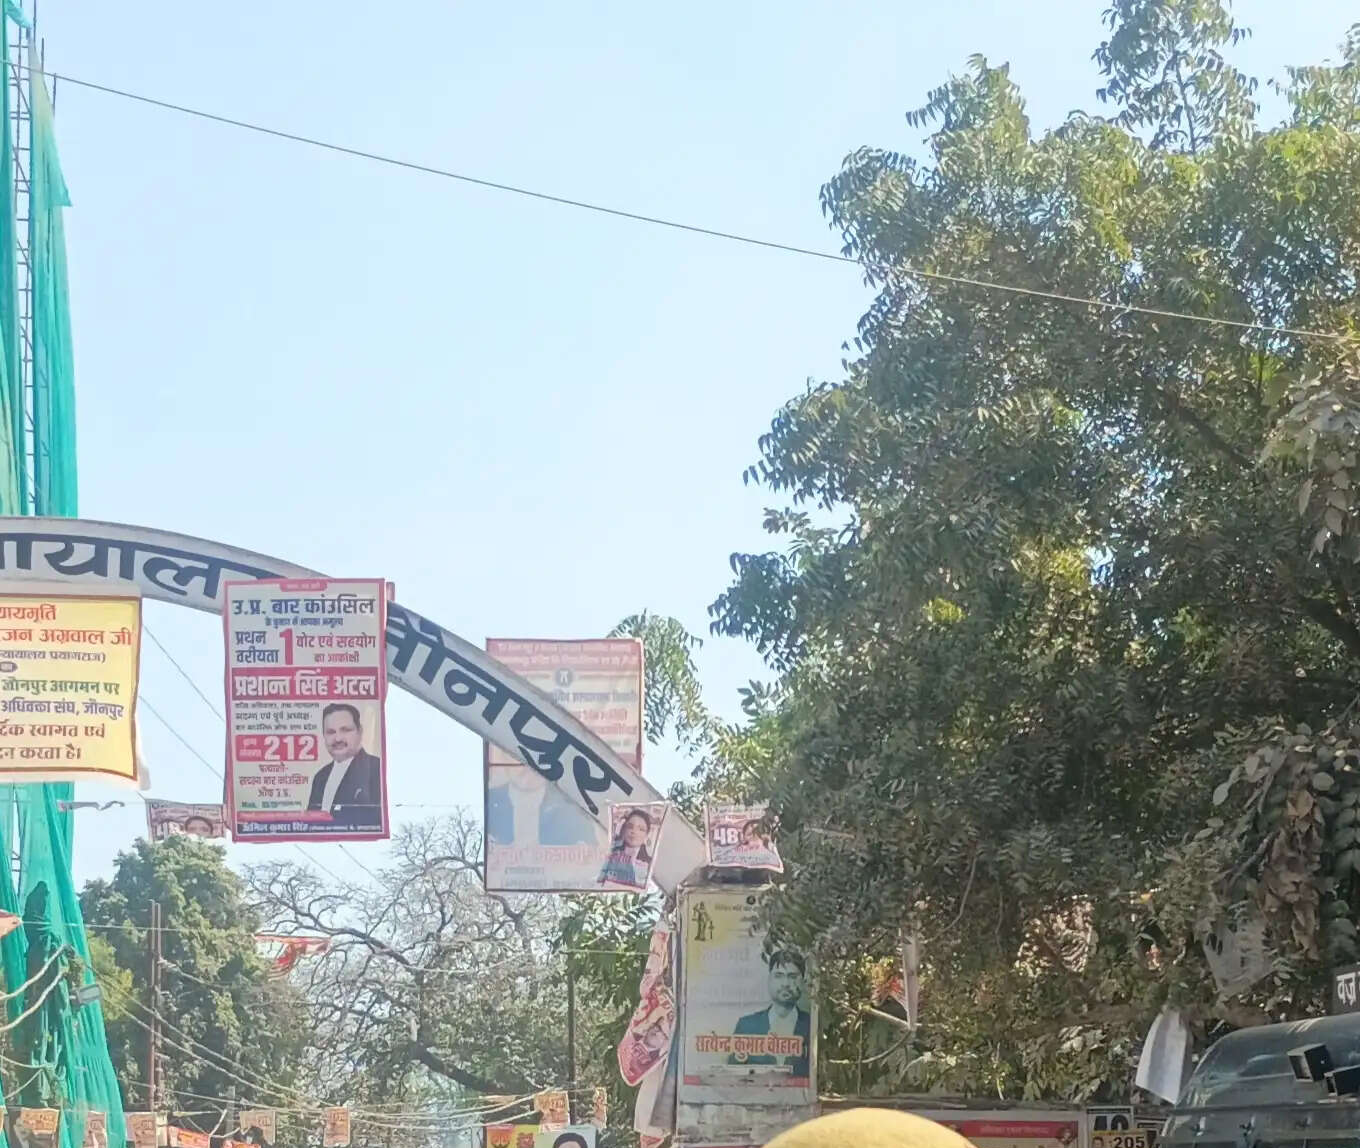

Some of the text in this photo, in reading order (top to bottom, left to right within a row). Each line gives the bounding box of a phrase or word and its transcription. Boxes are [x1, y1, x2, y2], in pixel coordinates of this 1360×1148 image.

[270, 599, 301, 614] बार
[39, 628, 105, 646] अग्रवाल
[110, 627, 133, 647] जी
[296, 632, 315, 648] वोट
[336, 632, 377, 649] सहयोग
[235, 646, 280, 664] वरीयता
[1, 676, 48, 696] जौनपुर
[50, 679, 100, 694] आगमन
[103, 682, 121, 696] पर
[295, 669, 330, 697] सिंह
[333, 675, 377, 697] अटल
[83, 699, 125, 721] जौनपुर
[30, 722, 79, 739] स्वागत
[84, 723, 107, 739] एवं
[19, 746, 62, 761] करता
[264, 735, 316, 761] 212
[1336, 971, 1357, 1007] वज्र
[734, 1034, 765, 1060] कुमार
[765, 1031, 803, 1055] चौहान
